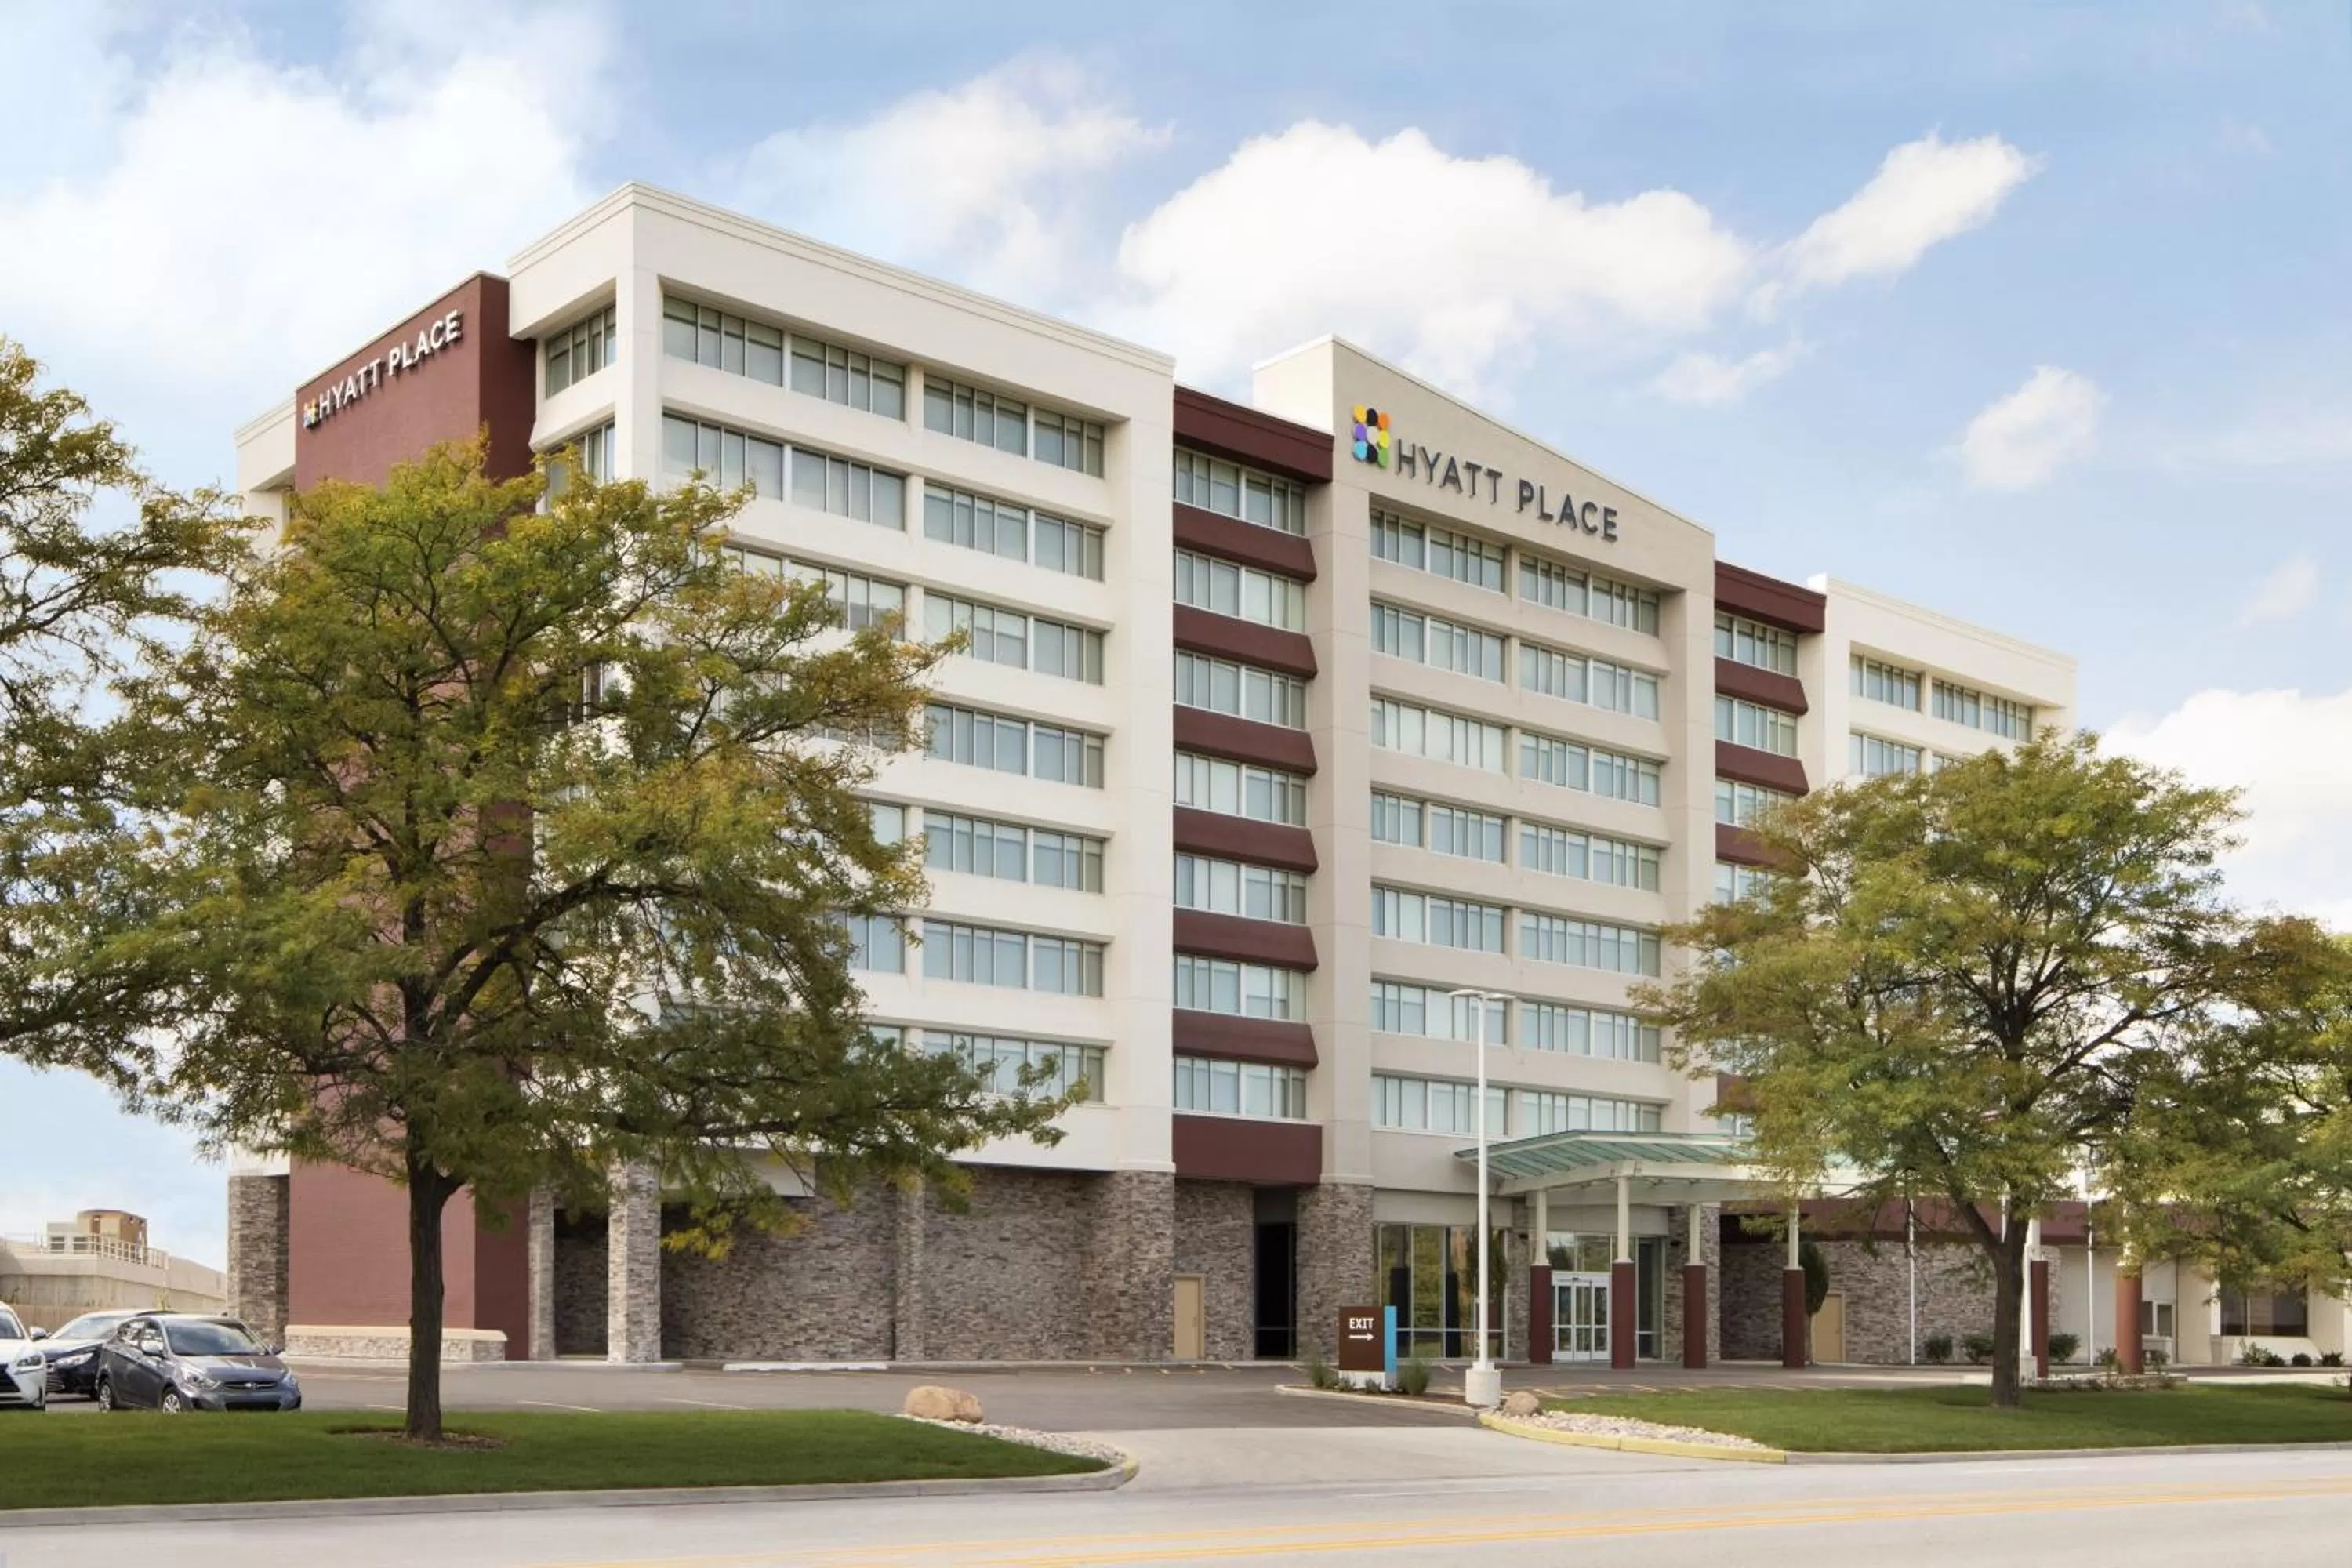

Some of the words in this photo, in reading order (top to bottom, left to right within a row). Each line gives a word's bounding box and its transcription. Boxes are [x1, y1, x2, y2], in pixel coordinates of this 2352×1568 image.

[318, 358, 381, 419] HYATT
[388, 310, 460, 376] PLACE
[1396, 439, 1503, 504] HYATT
[1517, 478, 1618, 543] PLACE
[1349, 1317, 1374, 1329] EXIT
